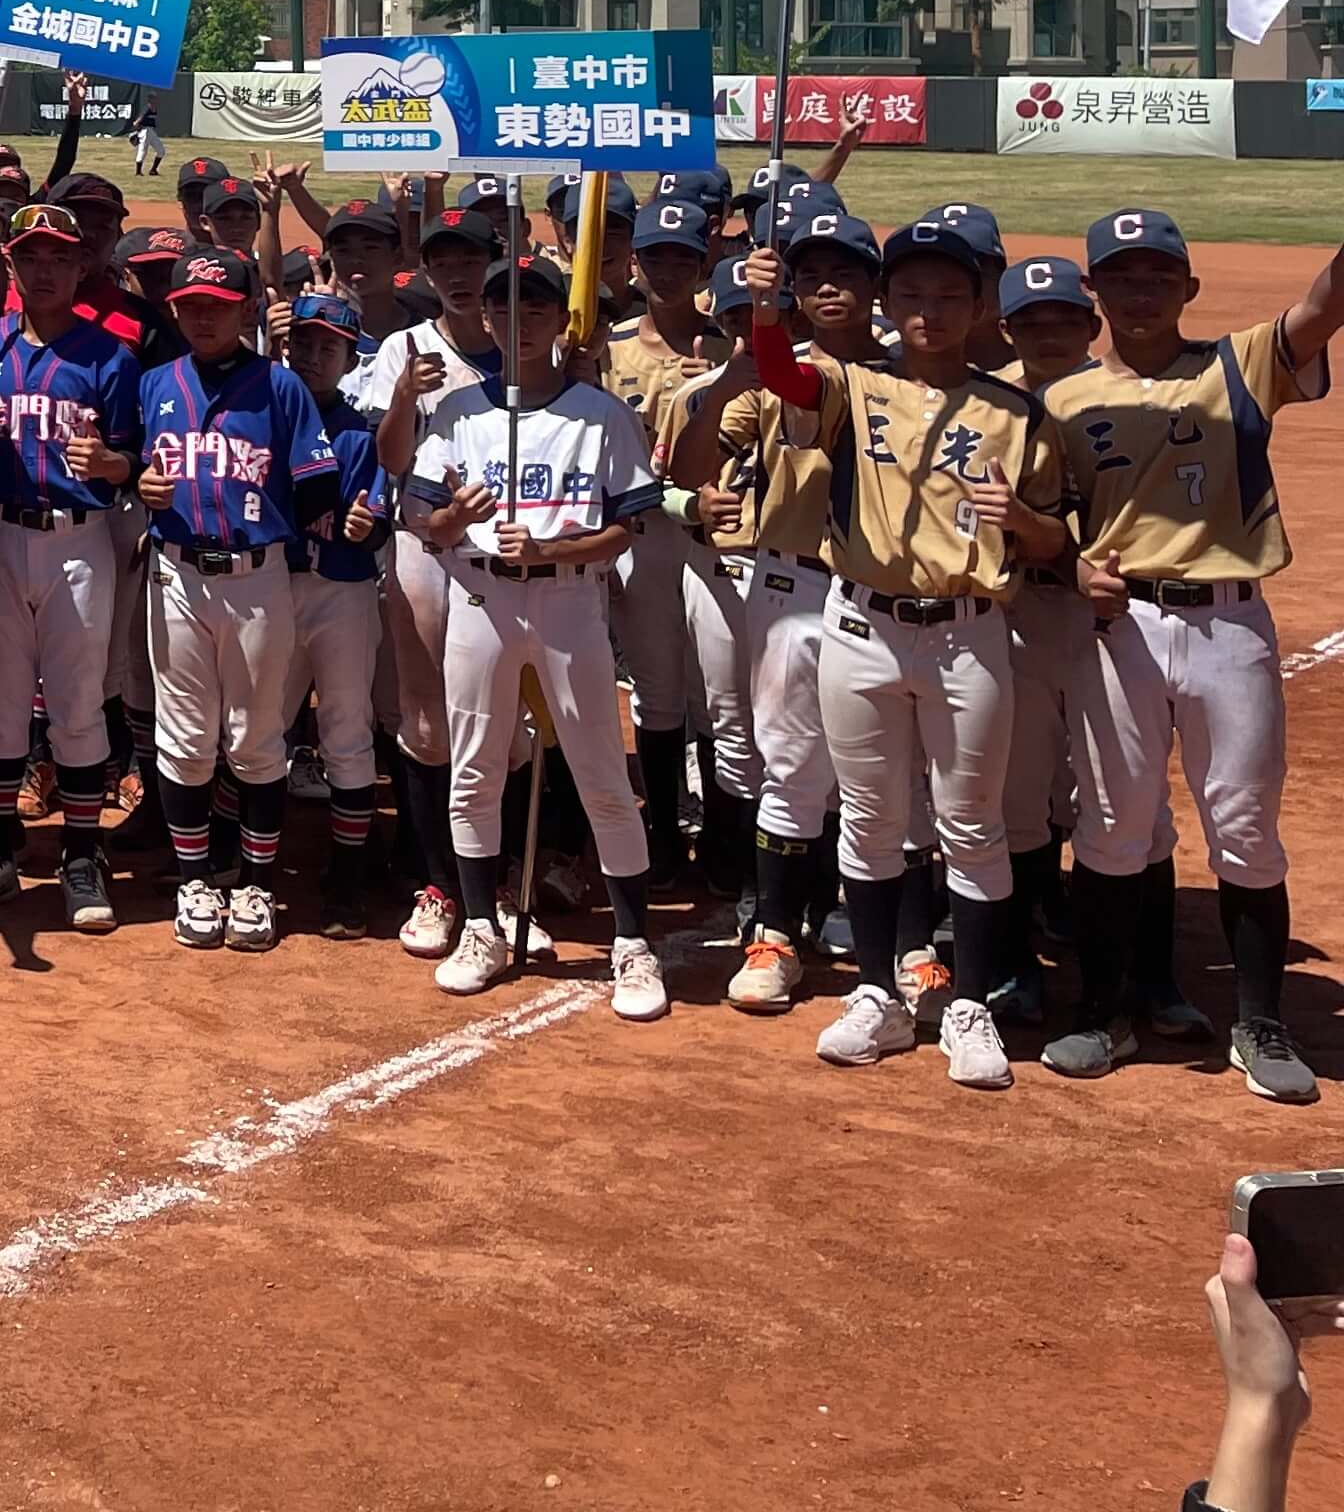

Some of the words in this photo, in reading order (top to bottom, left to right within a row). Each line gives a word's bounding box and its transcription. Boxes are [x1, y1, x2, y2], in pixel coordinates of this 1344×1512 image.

[8, 1, 161, 59] 金城國中B
[532, 54, 648, 90] 臺中市
[340, 96, 433, 124] 太武盃
[494, 102, 691, 148] 東勢國中
[1071, 89, 1212, 125] 泉昇營造
[1175, 463, 1205, 506] 7
[244, 491, 262, 523] 2
